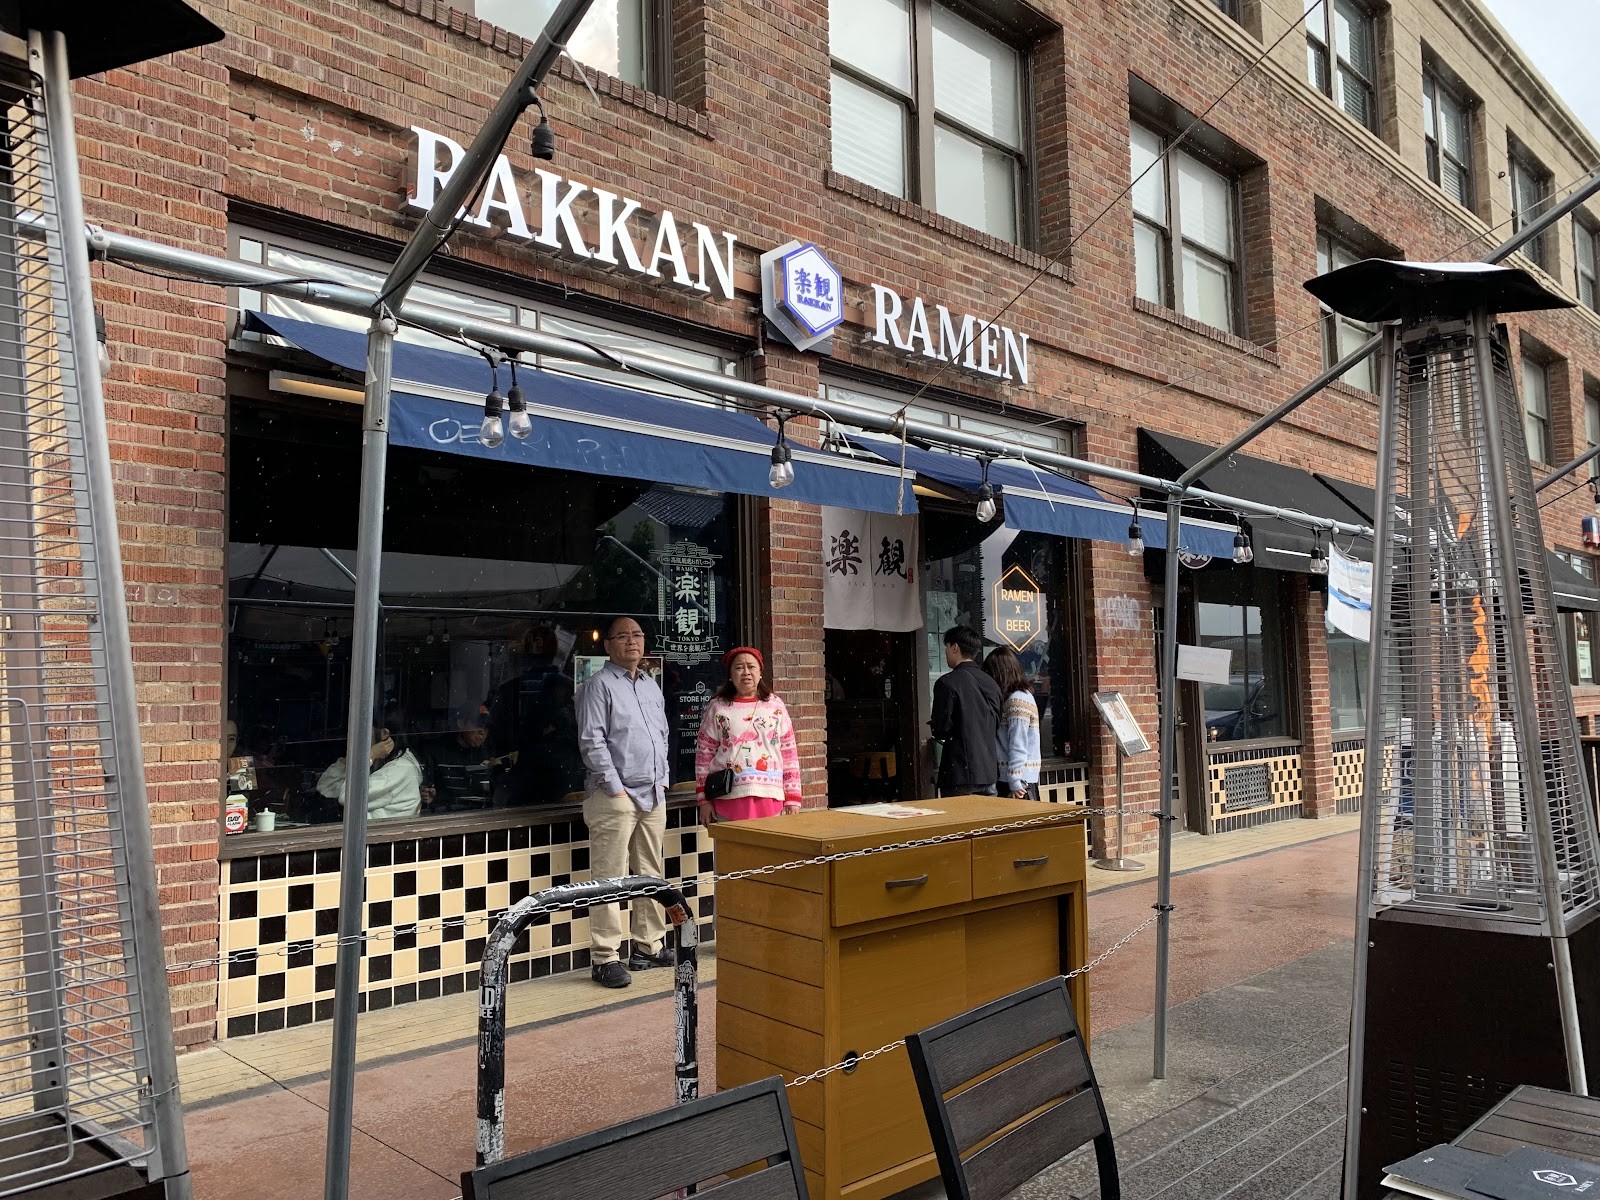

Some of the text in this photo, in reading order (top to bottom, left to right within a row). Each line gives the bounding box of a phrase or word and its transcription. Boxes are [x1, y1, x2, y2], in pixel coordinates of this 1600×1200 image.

[408, 125, 737, 299] RAKKAN
[794, 268, 833, 301] 楽観
[871, 283, 1030, 384] RAMEN
[675, 572, 701, 636] 楽観
[1001, 589, 1034, 602] RAMEN
[1006, 619, 1031, 631] BEER
[679, 695, 700, 703] STORE
